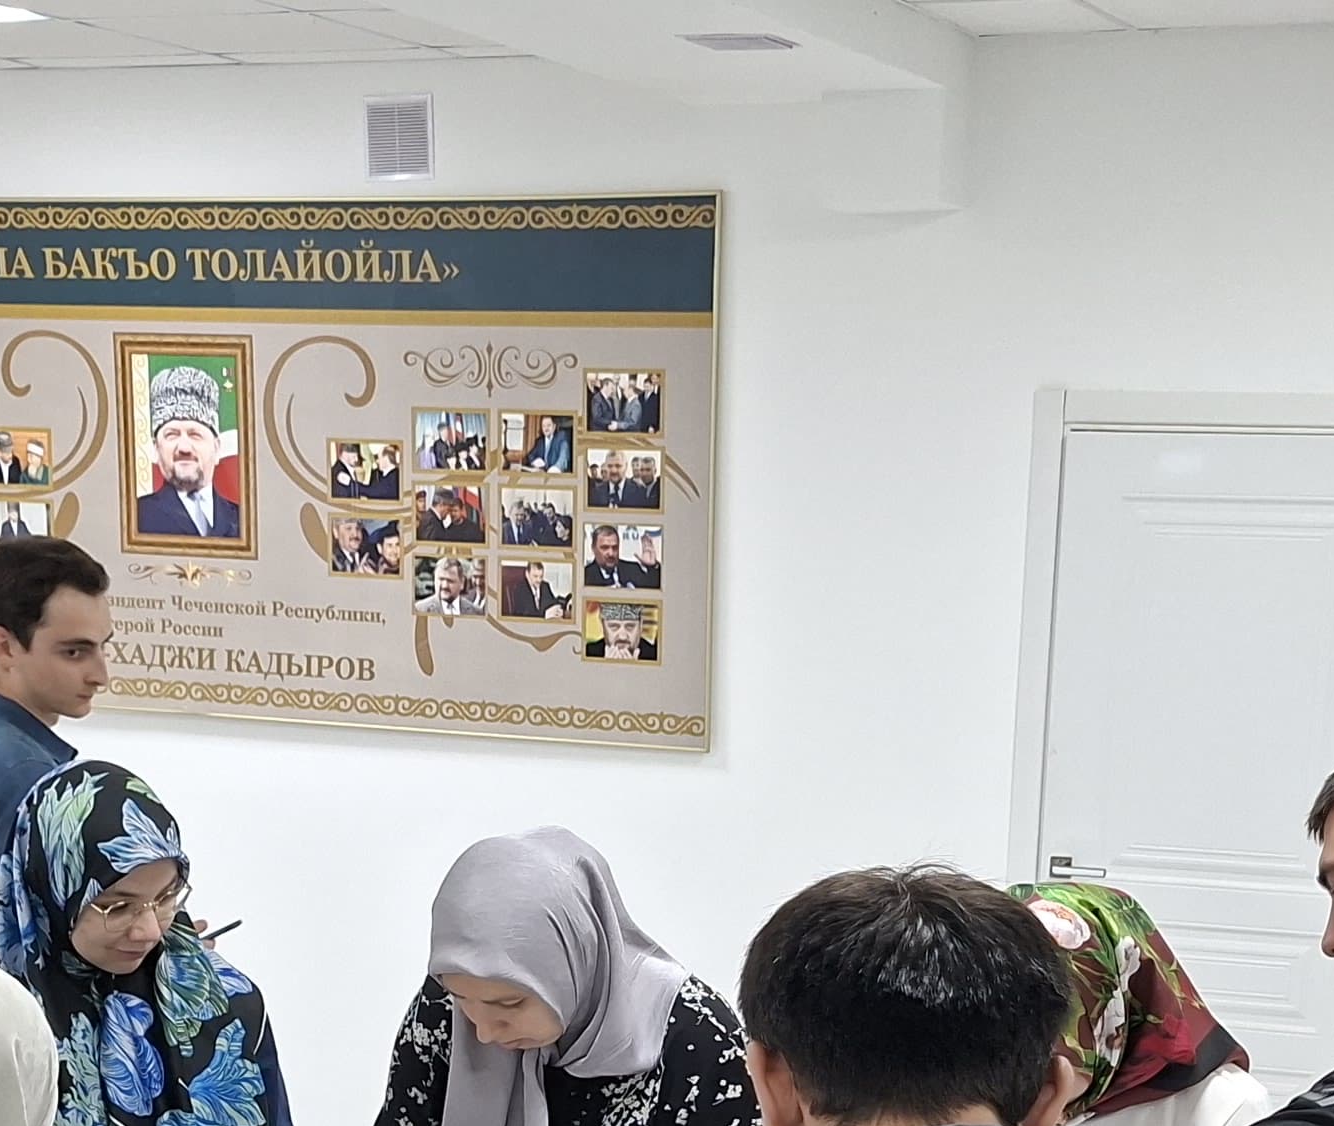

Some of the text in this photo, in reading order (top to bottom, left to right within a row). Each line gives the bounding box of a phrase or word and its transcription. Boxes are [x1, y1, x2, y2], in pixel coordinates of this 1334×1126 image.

[43, 247, 177, 281] БАКЪО
[184, 239, 460, 283] ТОЛАЙОЙЛА»
[107, 595, 386, 626] зидент Чеченской Республики,
[112, 617, 224, 638] ерой России
[105, 640, 376, 682] -ХАДЖИ КАДЫРОВ
